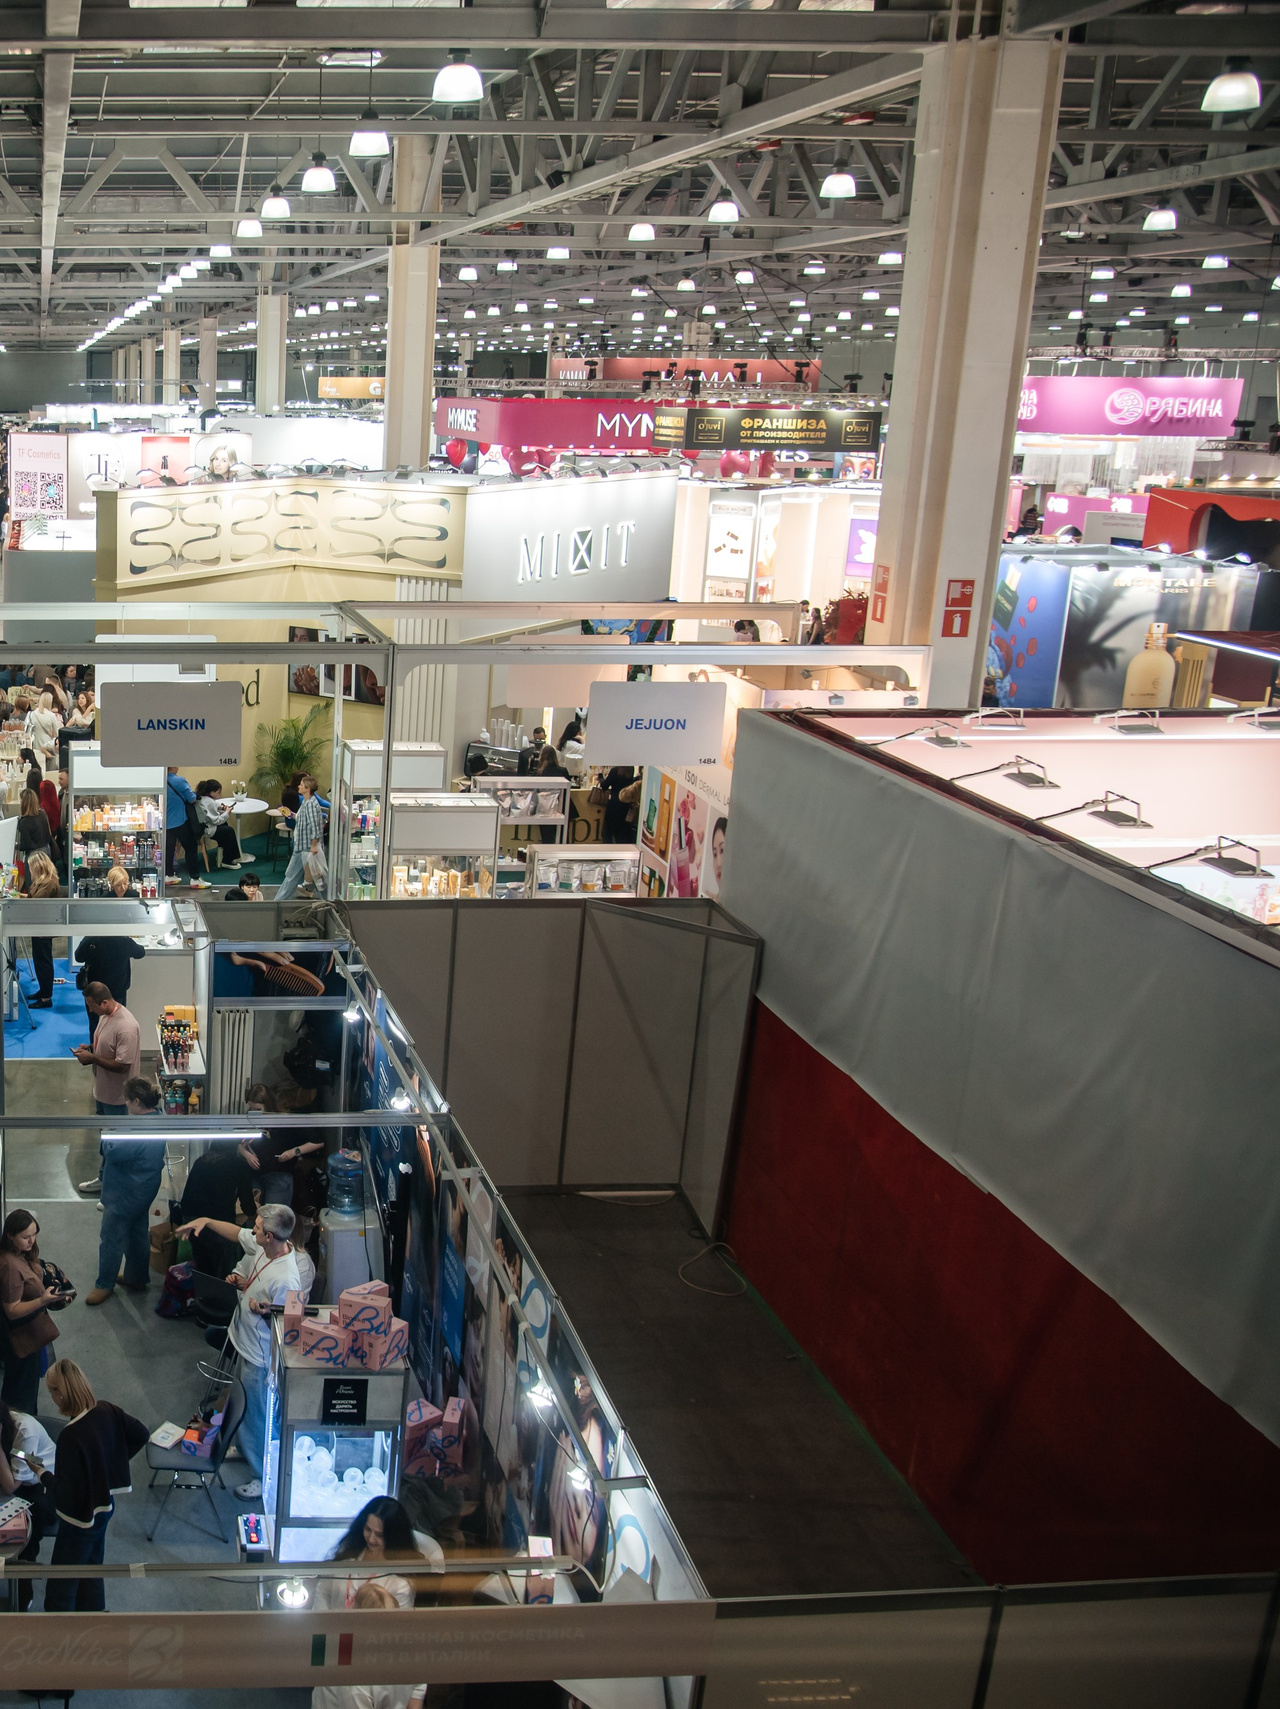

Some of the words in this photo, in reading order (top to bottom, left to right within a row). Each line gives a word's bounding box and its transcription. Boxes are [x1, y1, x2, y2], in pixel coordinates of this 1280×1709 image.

[1145, 396, 1223, 422] РЯБИНА
[447, 407, 477, 432] MYMUSE
[741, 418, 827, 429] ФРАНШИЗА
[753, 430, 827, 439] ПРОИЗВОДИТЕЛЯ
[27, 449, 61, 460] Cosmetics
[1113, 578, 1217, 588] MONTALE
[137, 718, 206, 731] LANSKIN
[625, 718, 687, 731] JEJUON
[218, 758, 238, 766] 14B4
[365, 1630, 465, 1645] АПТЕЧНАЯ
[469, 1627, 586, 1642] КОСМЕТИКА
[414, 1649, 490, 1662] ИТАЛИИ
